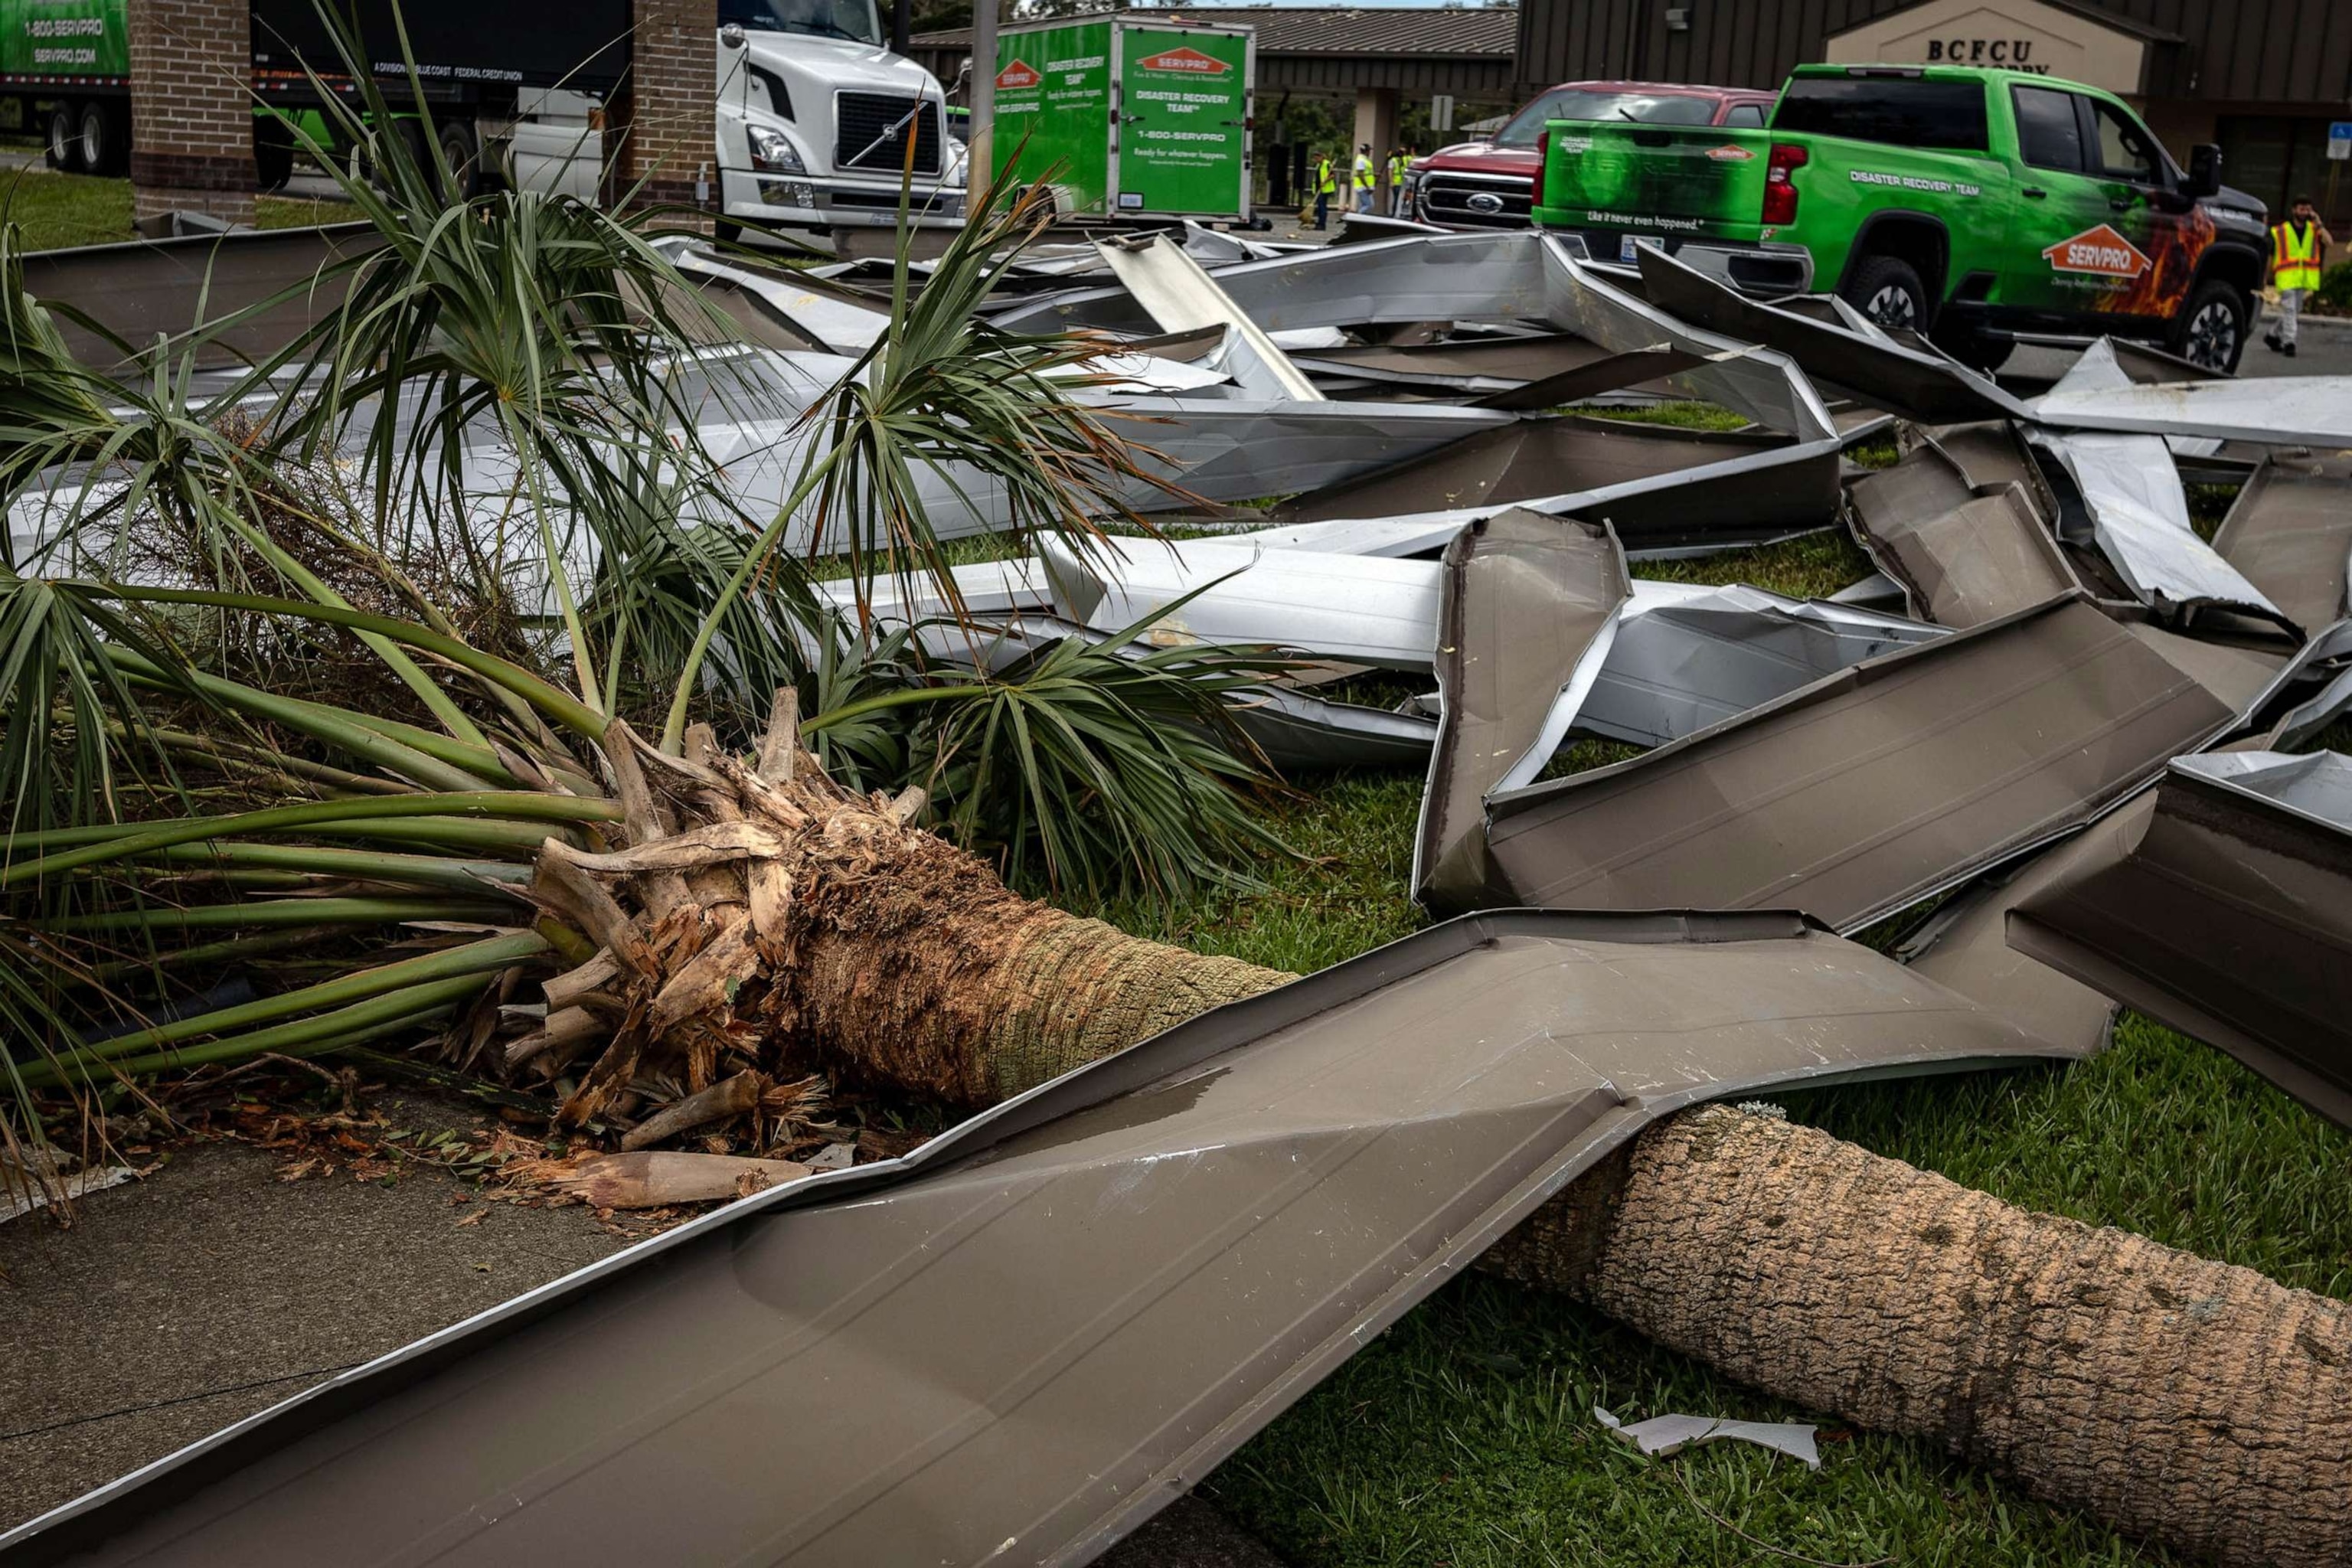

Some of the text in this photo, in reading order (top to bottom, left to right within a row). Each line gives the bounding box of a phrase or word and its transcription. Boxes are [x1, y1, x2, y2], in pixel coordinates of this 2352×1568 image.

[24, 18, 103, 38] 1-800-SERVPRO
[34, 48, 96, 64] SERVPRO.COM
[1927, 40, 2031, 61] BCFCU
[380, 63, 406, 74] DIVISION
[431, 65, 451, 76] COAST
[454, 67, 482, 78] FEDERAL
[482, 68, 503, 80] CREDIT
[504, 70, 522, 81] UNION
[1136, 90, 1230, 104] DISASTER RECOVERY
[1137, 130, 1226, 142] 1-800-SERVPRO
[1134, 147, 1155, 158] Ready
[1157, 148, 1166, 156] for
[1168, 149, 1198, 158] whatever
[1850, 170, 1980, 196] DISASTER RECOVERY TEAM
[1587, 211, 1602, 221] Like
[1604, 212, 1609, 222] it
[1610, 214, 1633, 224] never
[1634, 216, 1653, 225] even
[2067, 243, 2131, 268] SERVPRO
